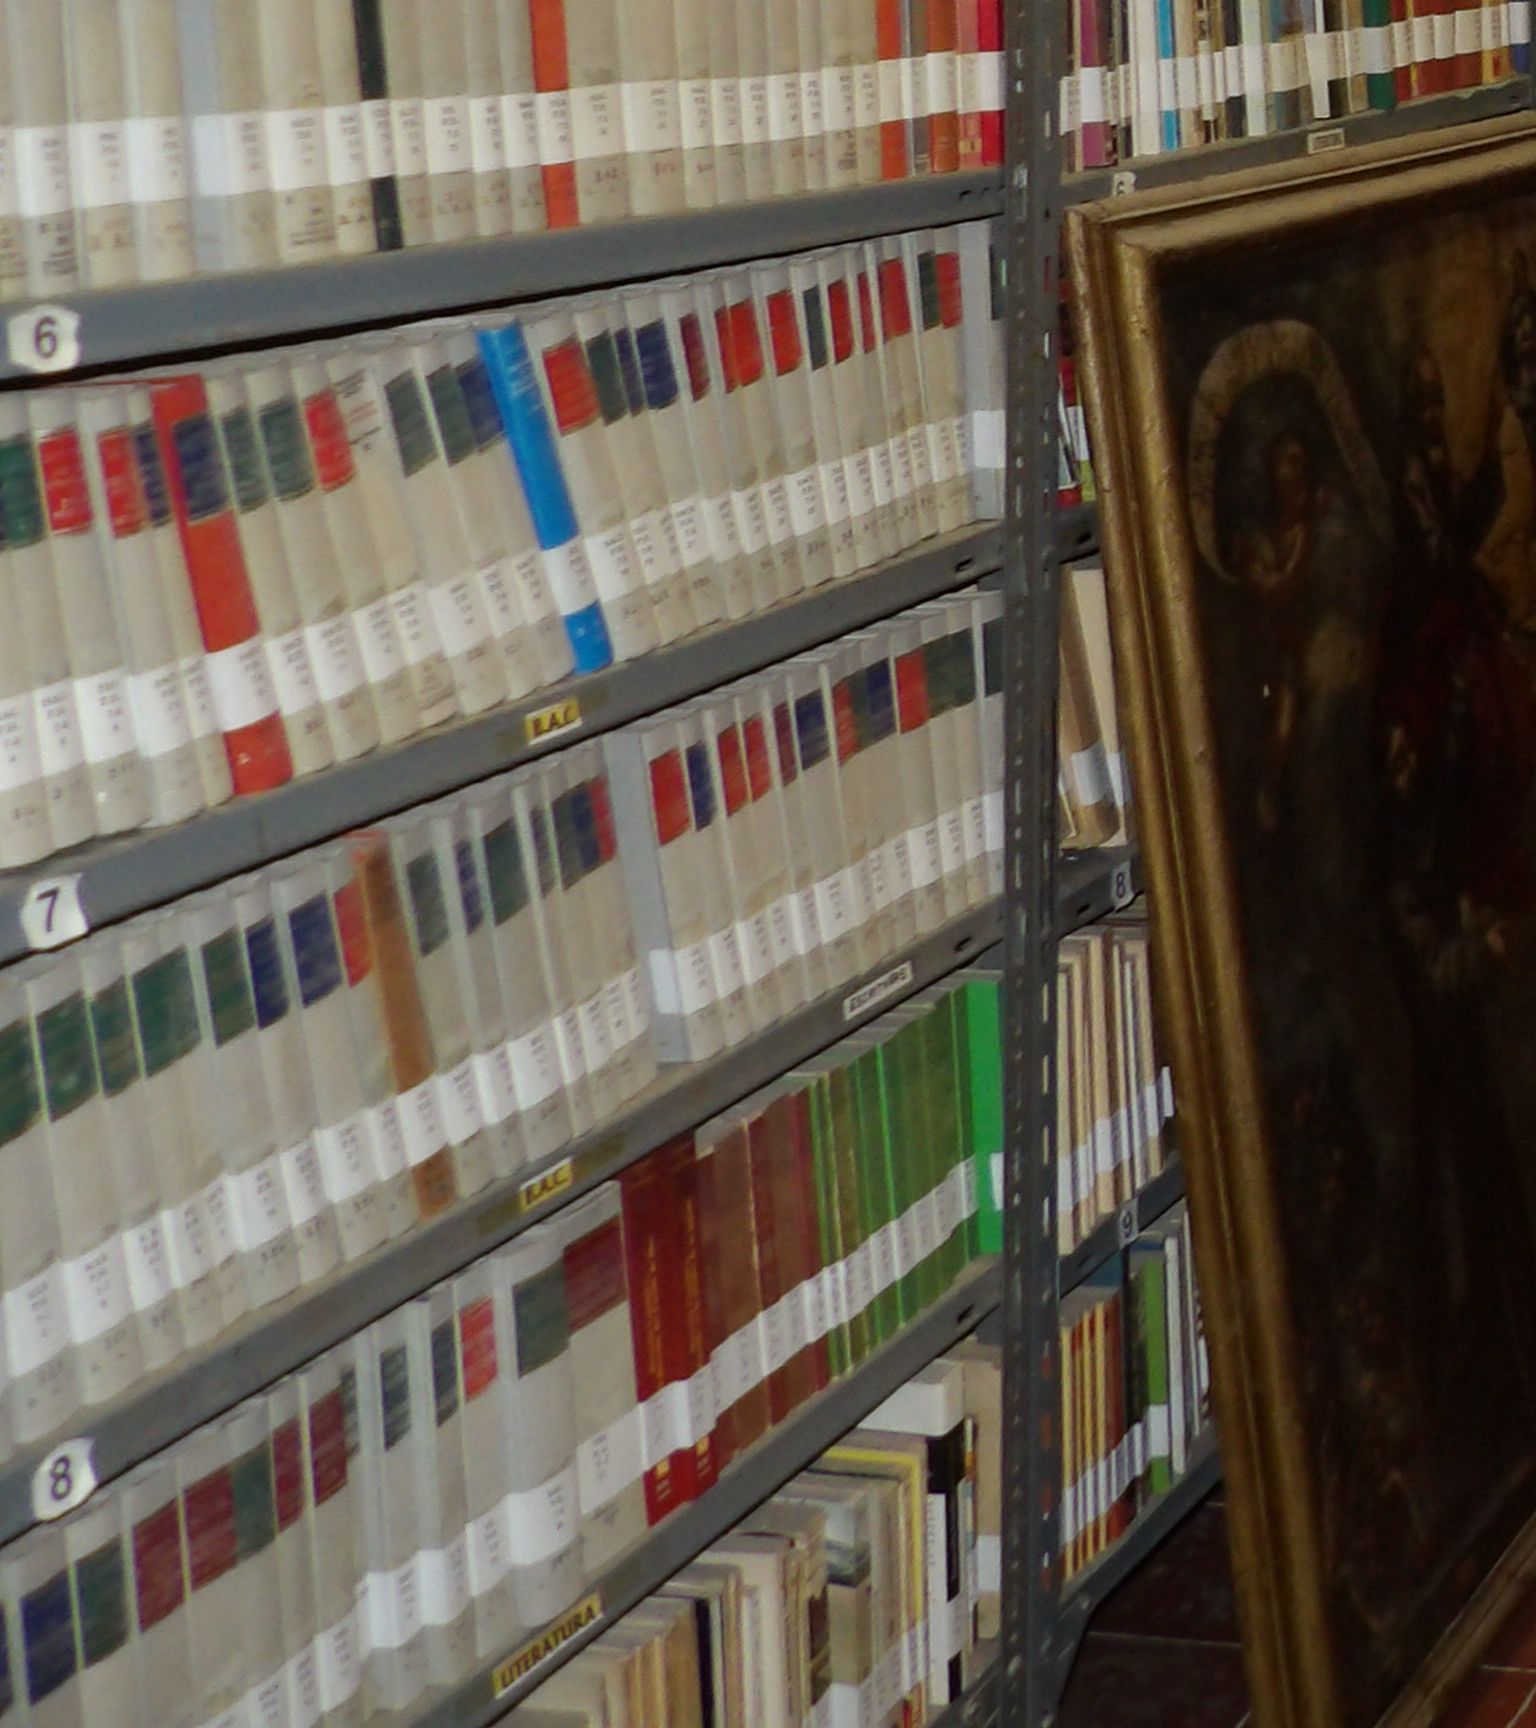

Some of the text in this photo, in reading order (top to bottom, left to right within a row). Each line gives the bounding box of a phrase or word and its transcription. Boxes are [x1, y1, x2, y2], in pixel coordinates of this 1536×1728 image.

[33, 314, 58, 359] 6
[1115, 870, 1127, 900] 8
[36, 886, 60, 933] 7
[1121, 1209, 1133, 1238] 9
[47, 1455, 72, 1501] 8
[501, 1604, 597, 1687] LITERATURA
